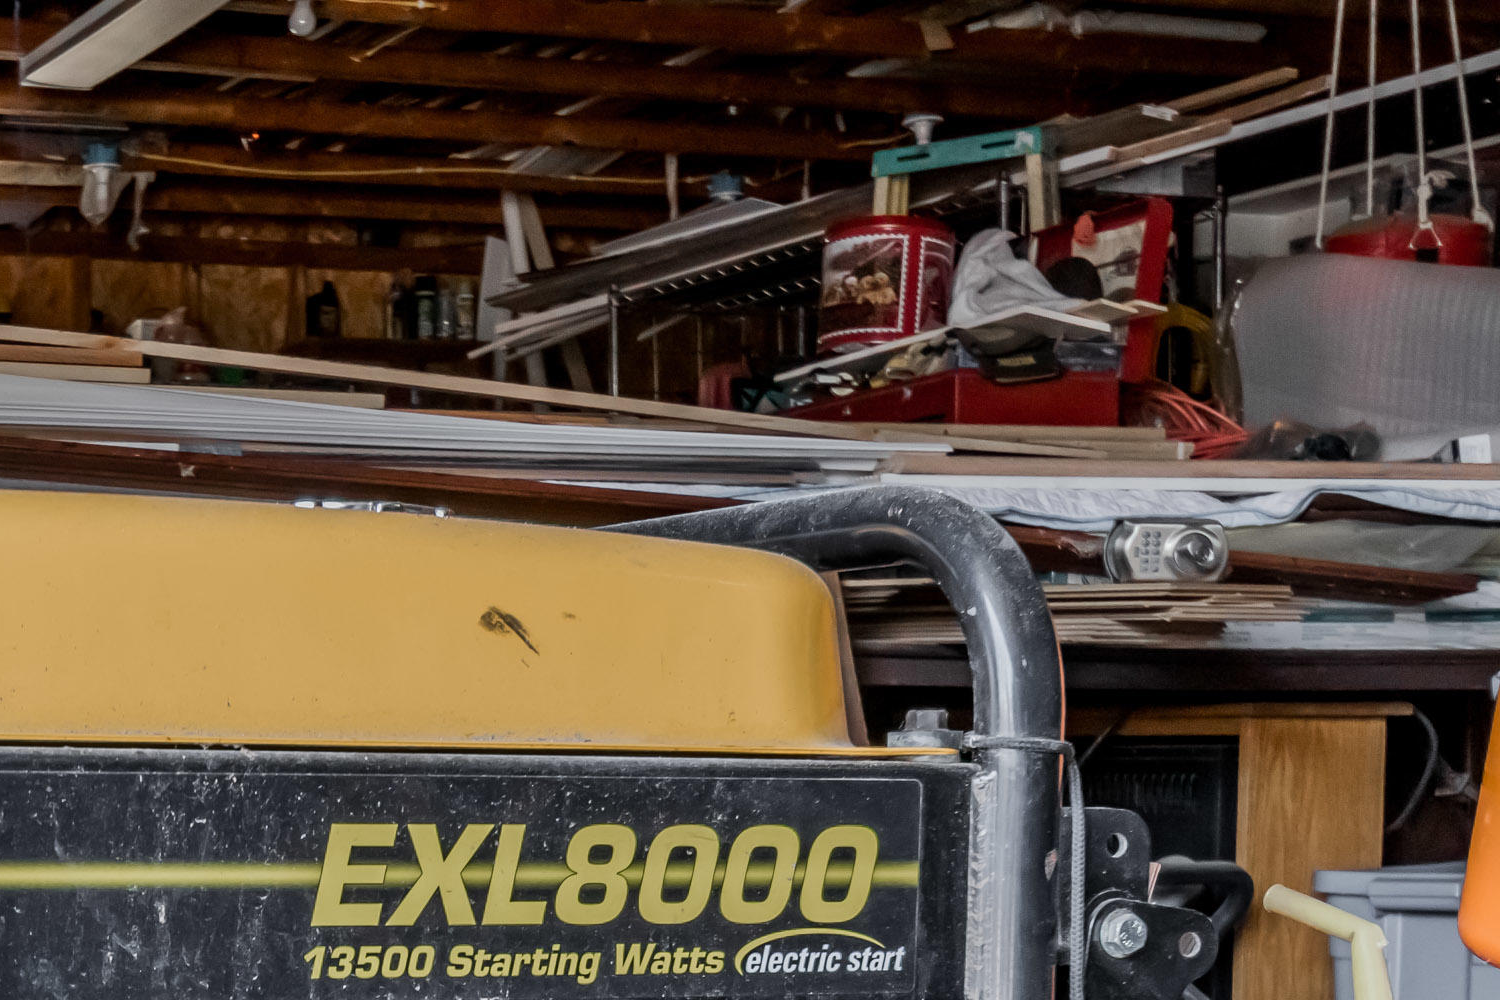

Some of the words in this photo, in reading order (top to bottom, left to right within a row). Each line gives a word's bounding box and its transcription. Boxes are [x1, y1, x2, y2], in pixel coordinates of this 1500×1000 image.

[310, 822, 879, 927] EXL8000
[303, 944, 436, 980] 13500
[446, 943, 602, 985] Starting
[614, 942, 725, 975] Watts
[745, 945, 843, 974] electric
[847, 946, 906, 972] start
